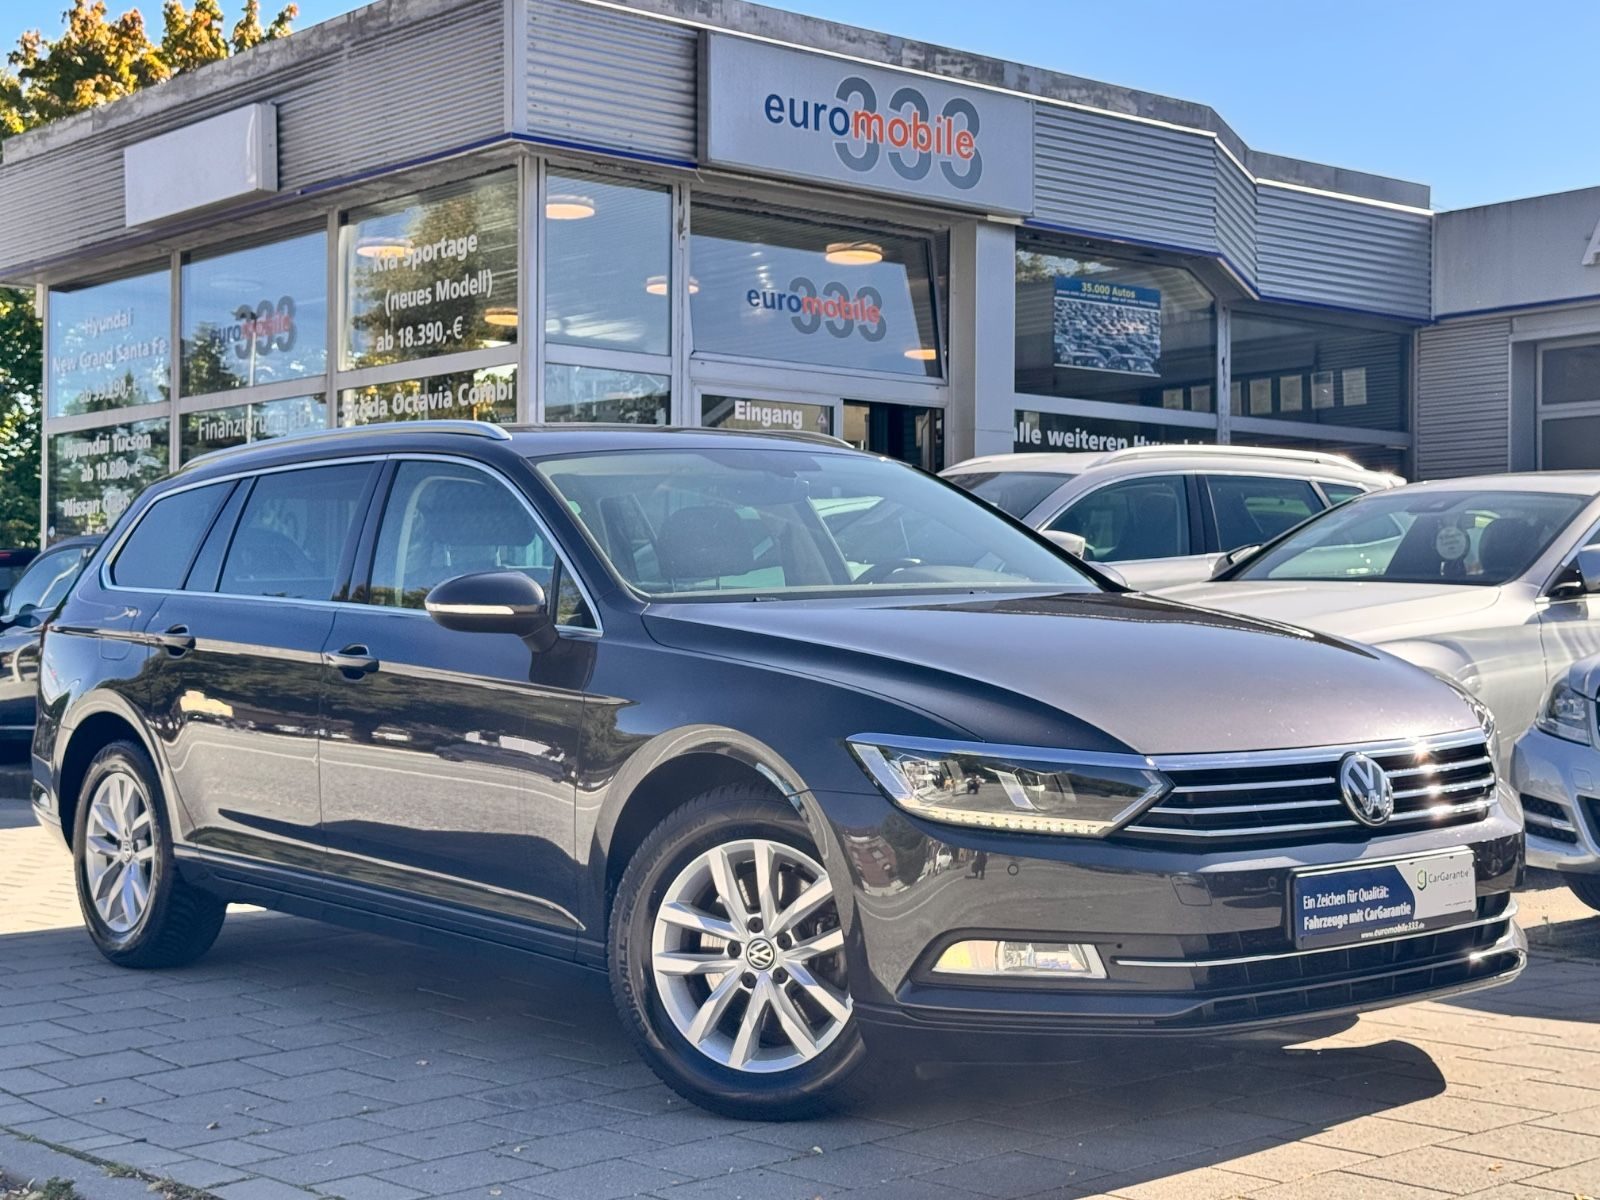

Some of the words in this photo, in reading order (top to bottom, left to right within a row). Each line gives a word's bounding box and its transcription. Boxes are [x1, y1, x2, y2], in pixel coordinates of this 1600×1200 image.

[764, 93, 975, 160] euromobile
[833, 76, 983, 190] 333
[384, 287, 432, 317] (neues
[435, 269, 493, 302] Modell)
[747, 288, 880, 323] euromobile
[1081, 282, 1110, 295] 35.000
[1112, 286, 1136, 299] Autos
[84, 308, 132, 338] Hyundai
[789, 277, 887, 342] 333
[376, 329, 394, 352] ab
[397, 316, 463, 348] 18.390,-€
[52, 357, 78, 373] New
[80, 344, 114, 368] Grand
[116, 340, 149, 362] Santa
[152, 336, 167, 355] Fe
[392, 386, 453, 414] Octavia
[458, 378, 514, 405] Combi
[734, 400, 803, 429] Eingang
[64, 434, 109, 463] Hyundai
[112, 433, 151, 453] Tucson
[1047, 428, 1128, 451] weiteren
[81, 463, 94, 482] ab
[64, 498, 100, 517] Nissan
[1303, 895, 1316, 910] Ein
[1317, 892, 1346, 909] Zeichen
[1347, 889, 1358, 904] für
[1359, 885, 1389, 902] Qualität:
[1304, 914, 1348, 930] Fahrzeuge
[1349, 909, 1364, 924] mit
[1365, 902, 1411, 920] CarGarantie
